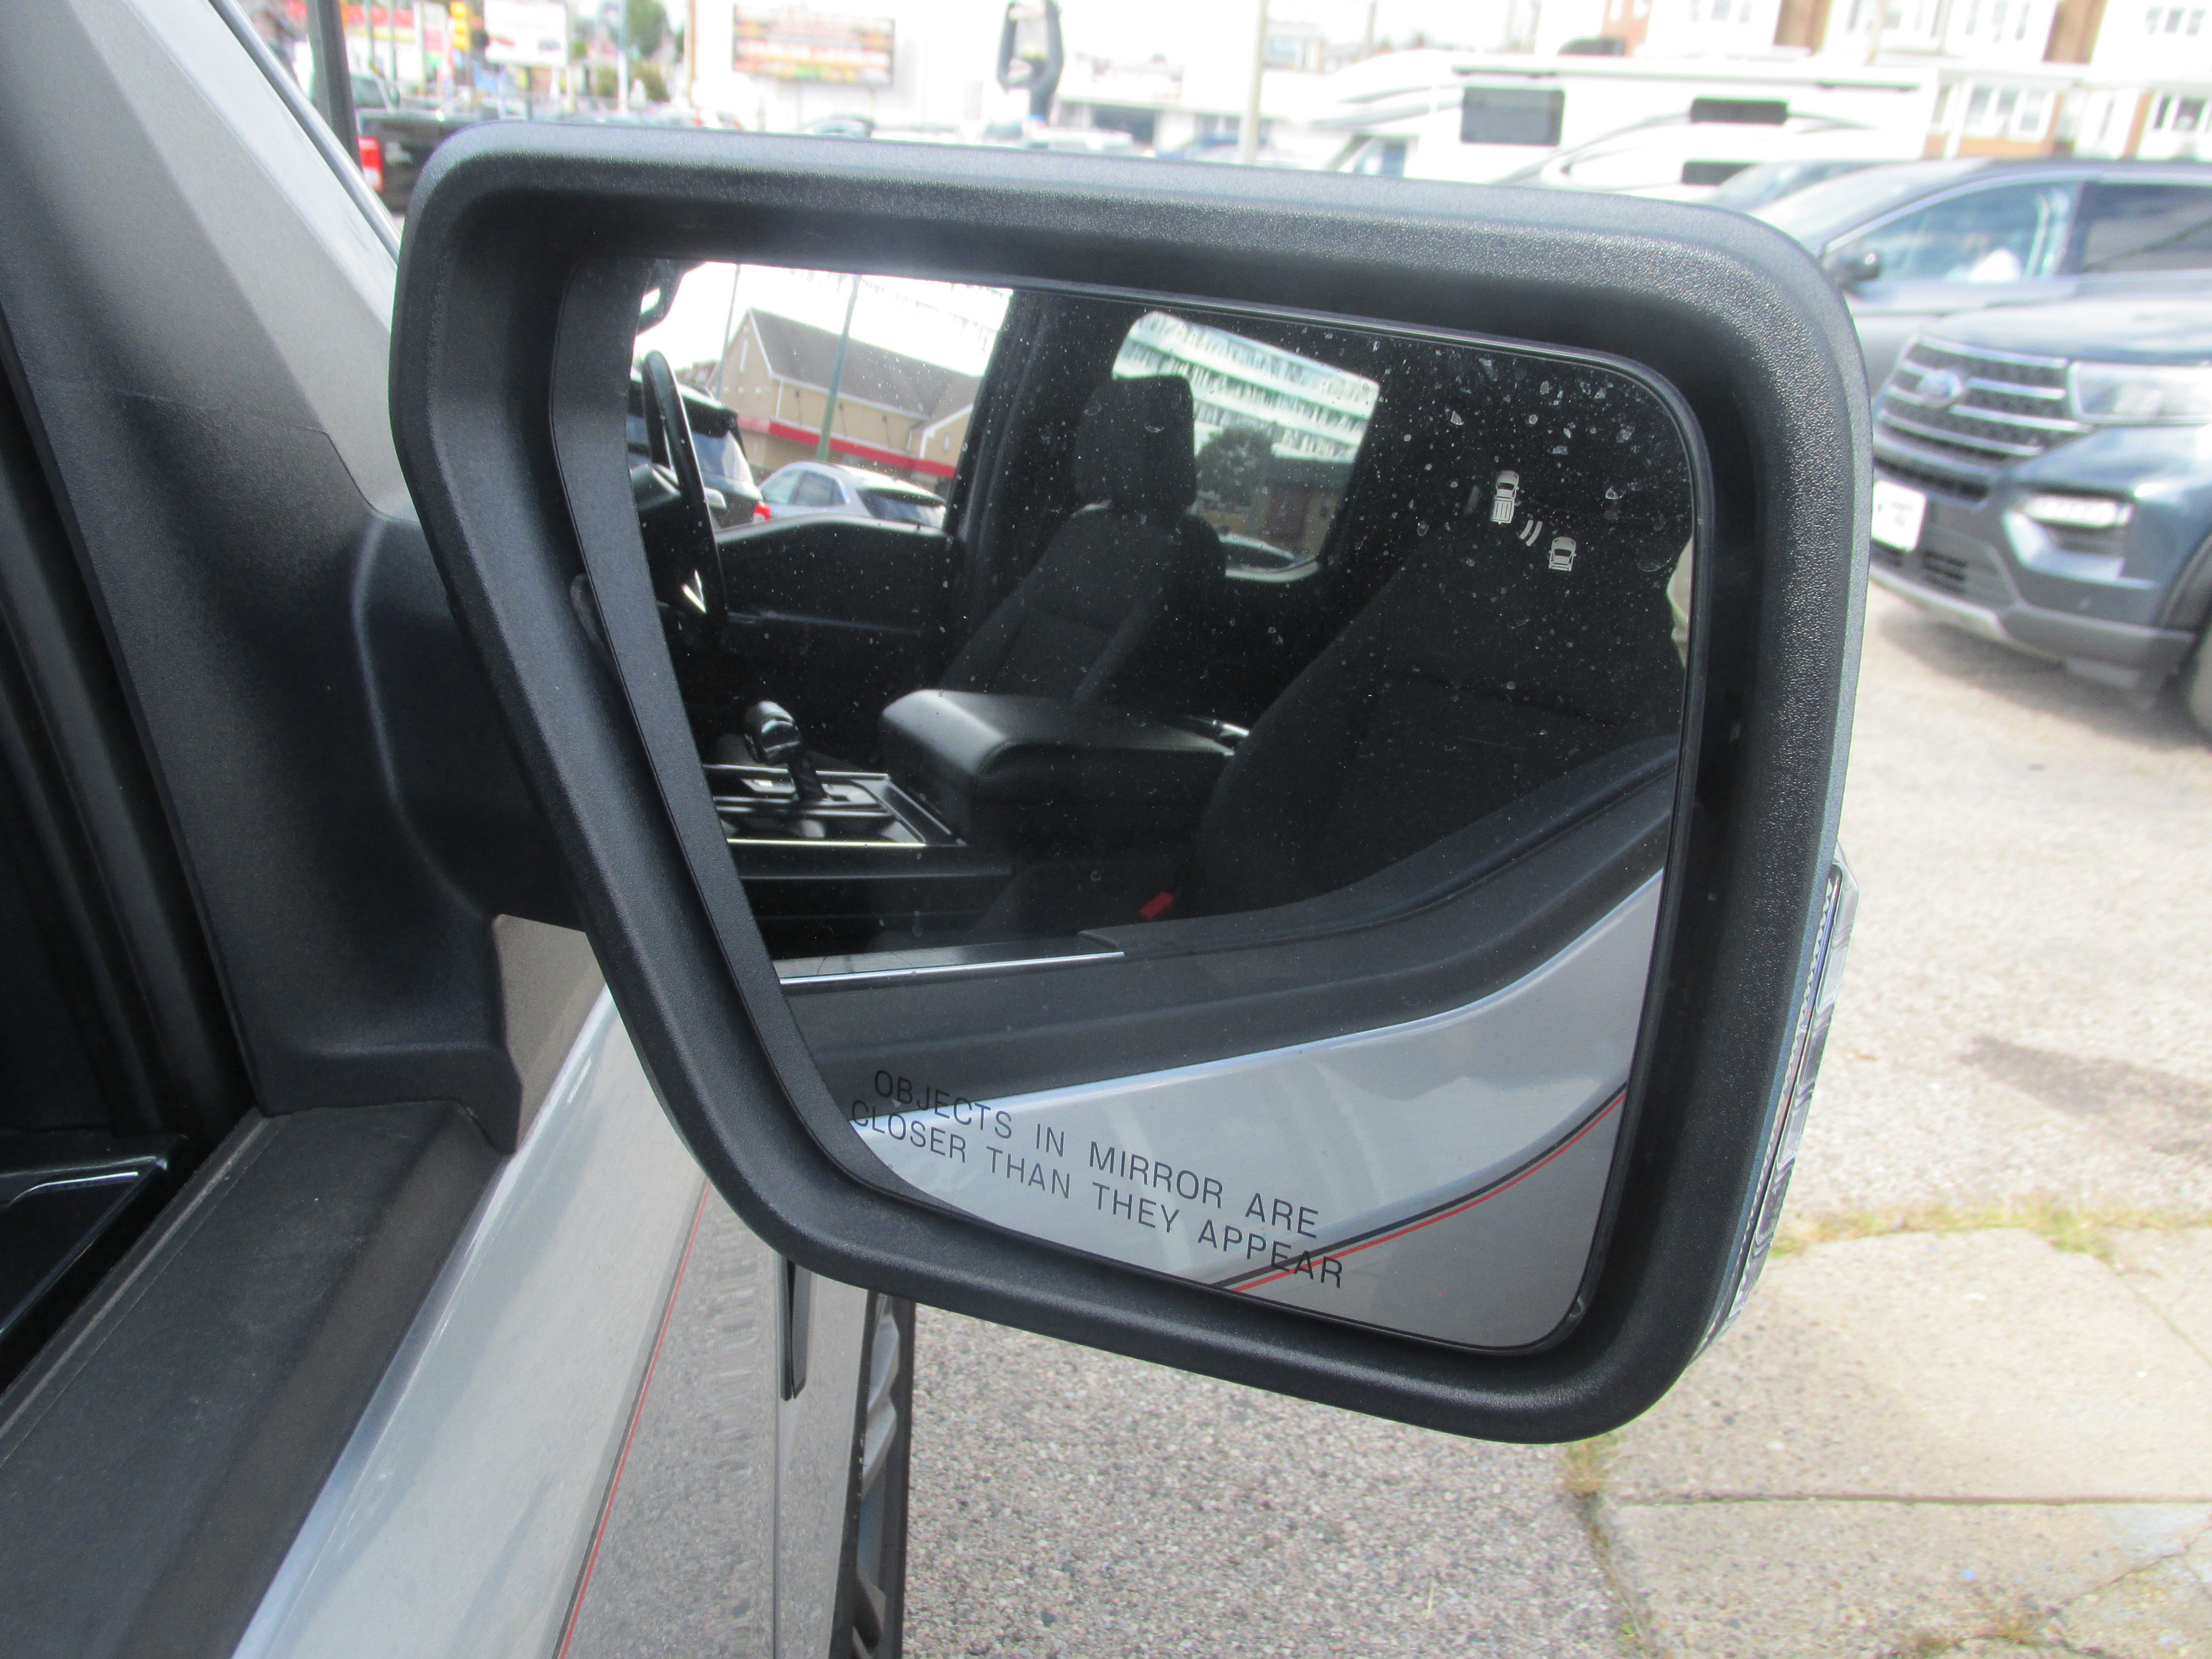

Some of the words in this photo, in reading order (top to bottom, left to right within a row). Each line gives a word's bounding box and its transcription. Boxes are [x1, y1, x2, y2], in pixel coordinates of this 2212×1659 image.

[852, 1100, 966, 1163] CLOSER
[986, 1146, 1070, 1199] THAN
[1092, 1182, 1179, 1233] THEY
[1197, 1219, 1343, 1288] APPEAR
[875, 1070, 1012, 1139] OBJECTS
[1036, 1124, 1065, 1157] IN
[1089, 1141, 1223, 1209] MIRROR
[1245, 1193, 1319, 1238] ARE
